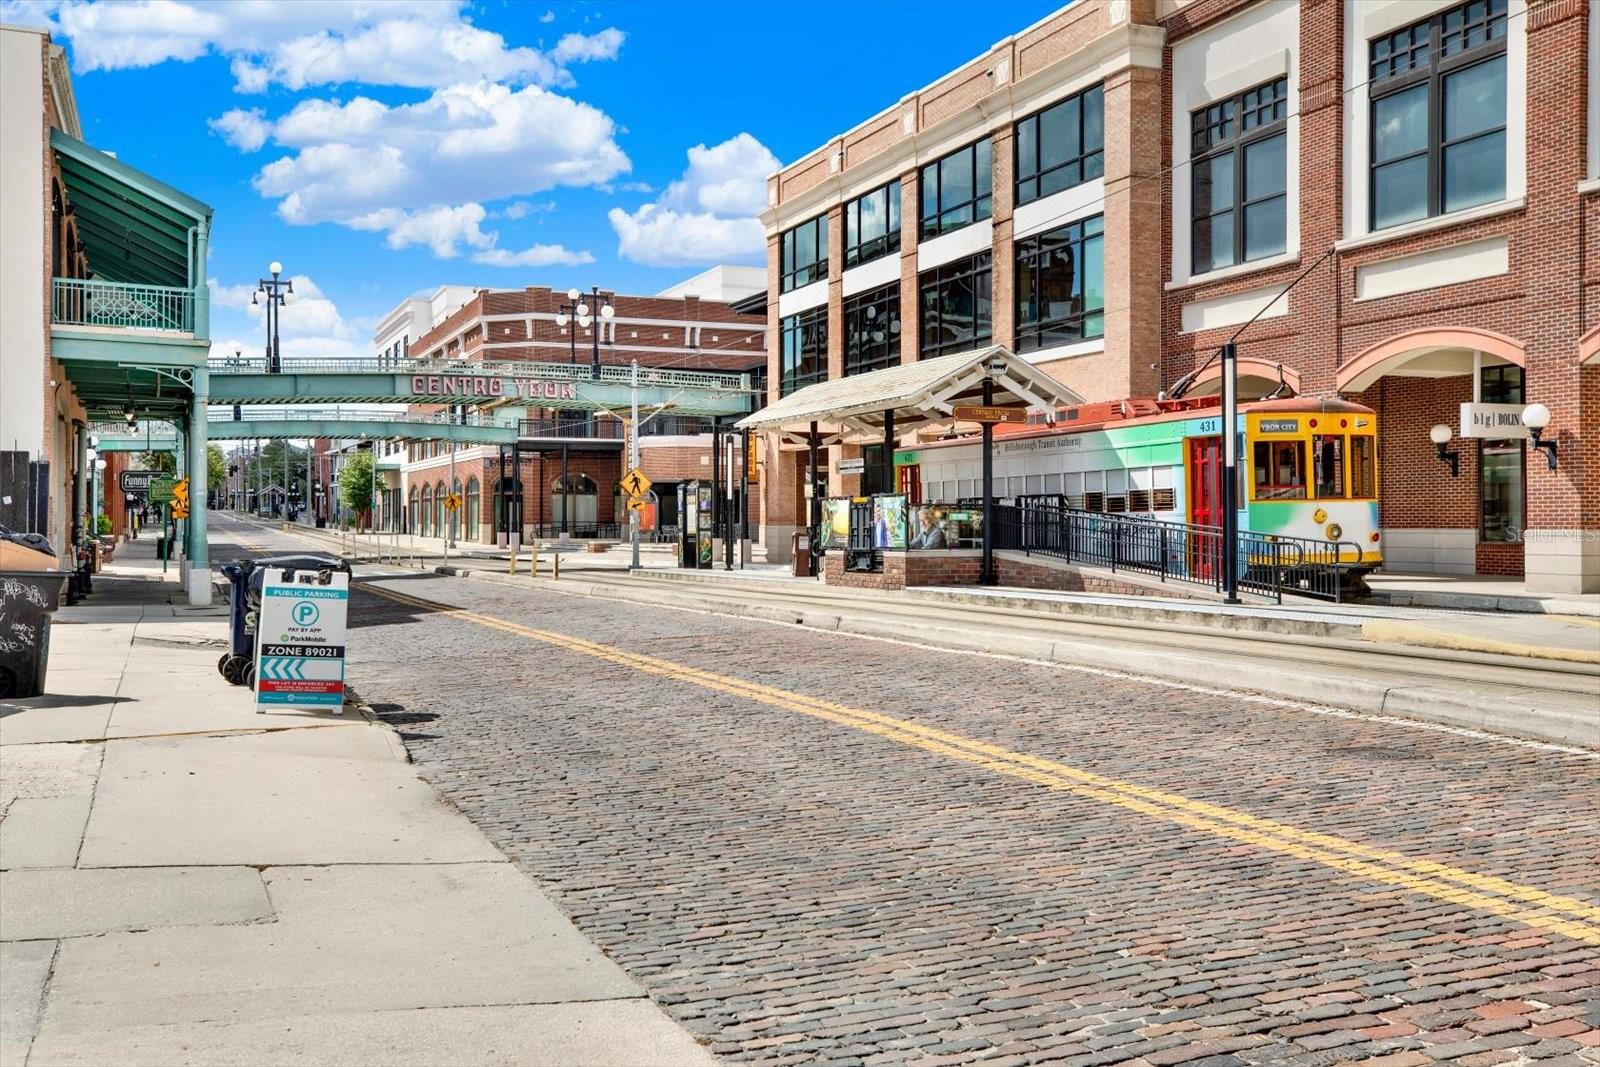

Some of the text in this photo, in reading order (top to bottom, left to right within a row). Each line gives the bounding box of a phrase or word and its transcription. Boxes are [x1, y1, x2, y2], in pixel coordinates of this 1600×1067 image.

[411, 375, 575, 399] CENTRO YBOR
[1498, 413, 1520, 426] BOLIN
[1200, 421, 1216, 432] 431
[1281, 423, 1297, 431] CITY
[1037, 439, 1055, 449] Transit
[1057, 437, 1081, 448] Authority
[273, 589, 302, 597] PUBLIC
[268, 647, 337, 657] ZONE 89021
